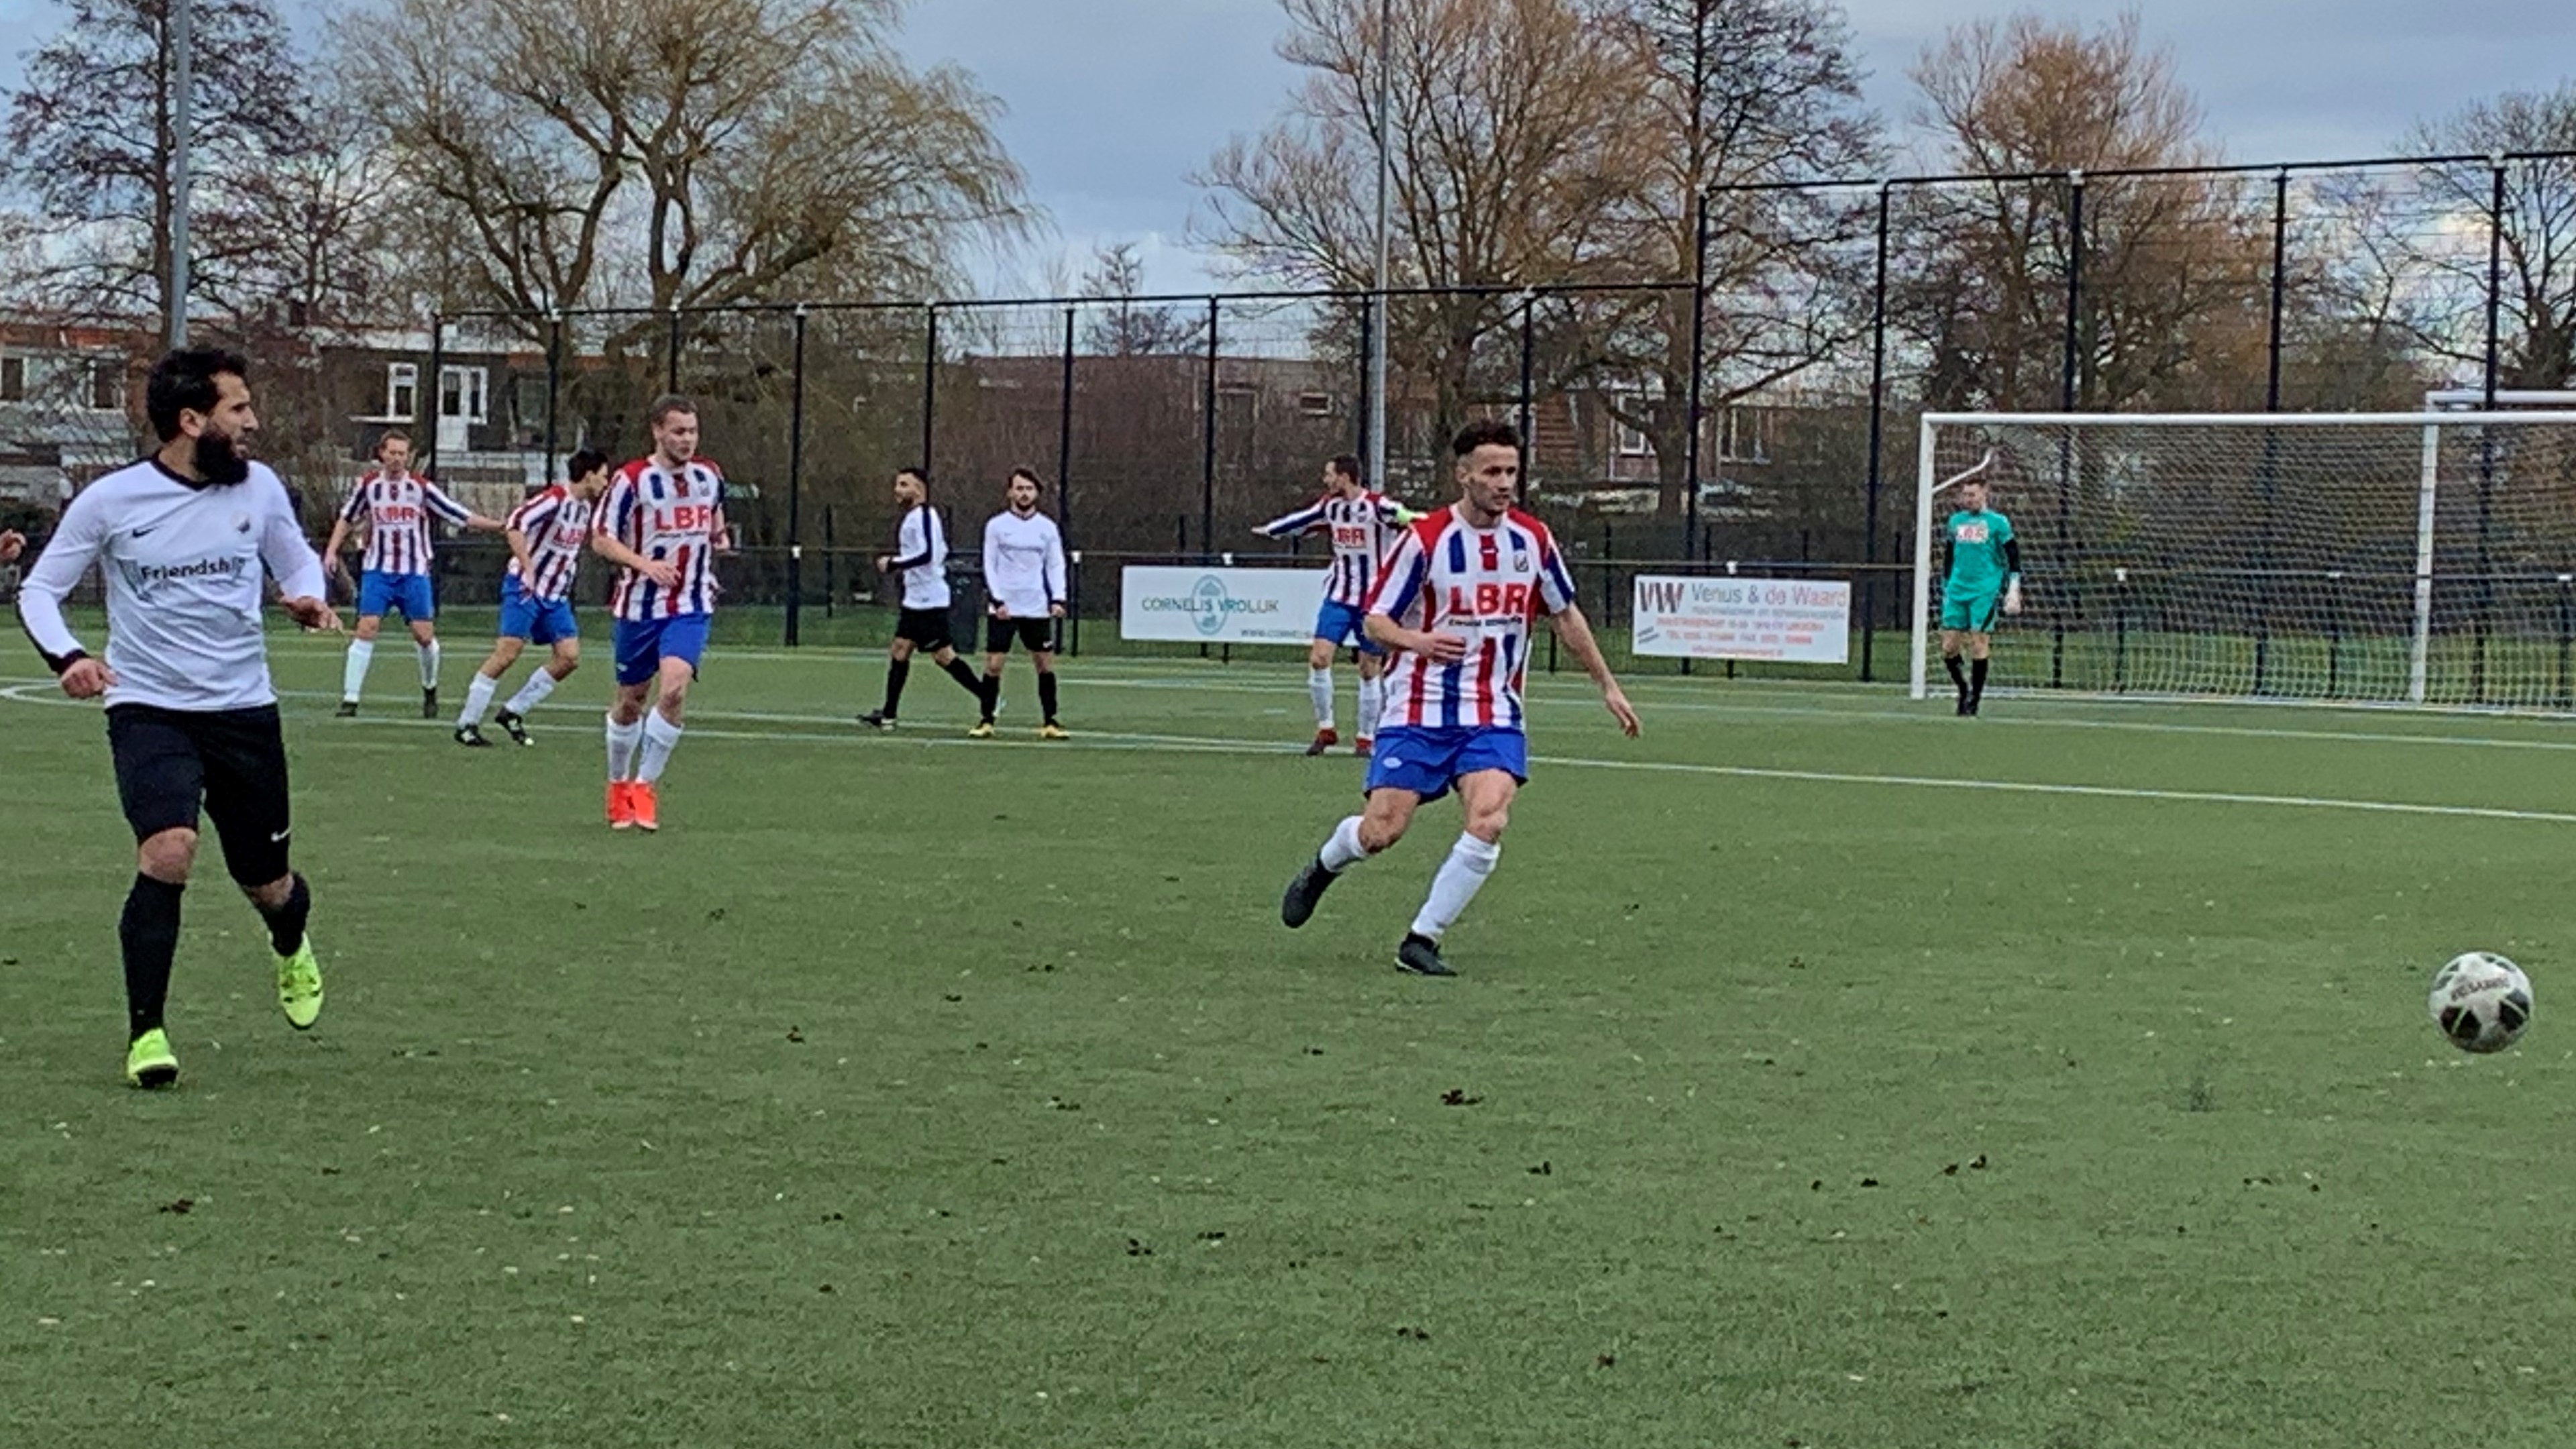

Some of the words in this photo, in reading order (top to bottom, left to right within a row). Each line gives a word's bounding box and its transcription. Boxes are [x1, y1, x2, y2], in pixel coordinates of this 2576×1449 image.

[1142, 598, 1213, 611] CORNELIS
[1448, 583, 1527, 615] LBR
[1691, 583, 1742, 603] Venus
[1748, 585, 1760, 603] &
[1765, 588, 1786, 604] de
[1792, 587, 1847, 607] Waard
